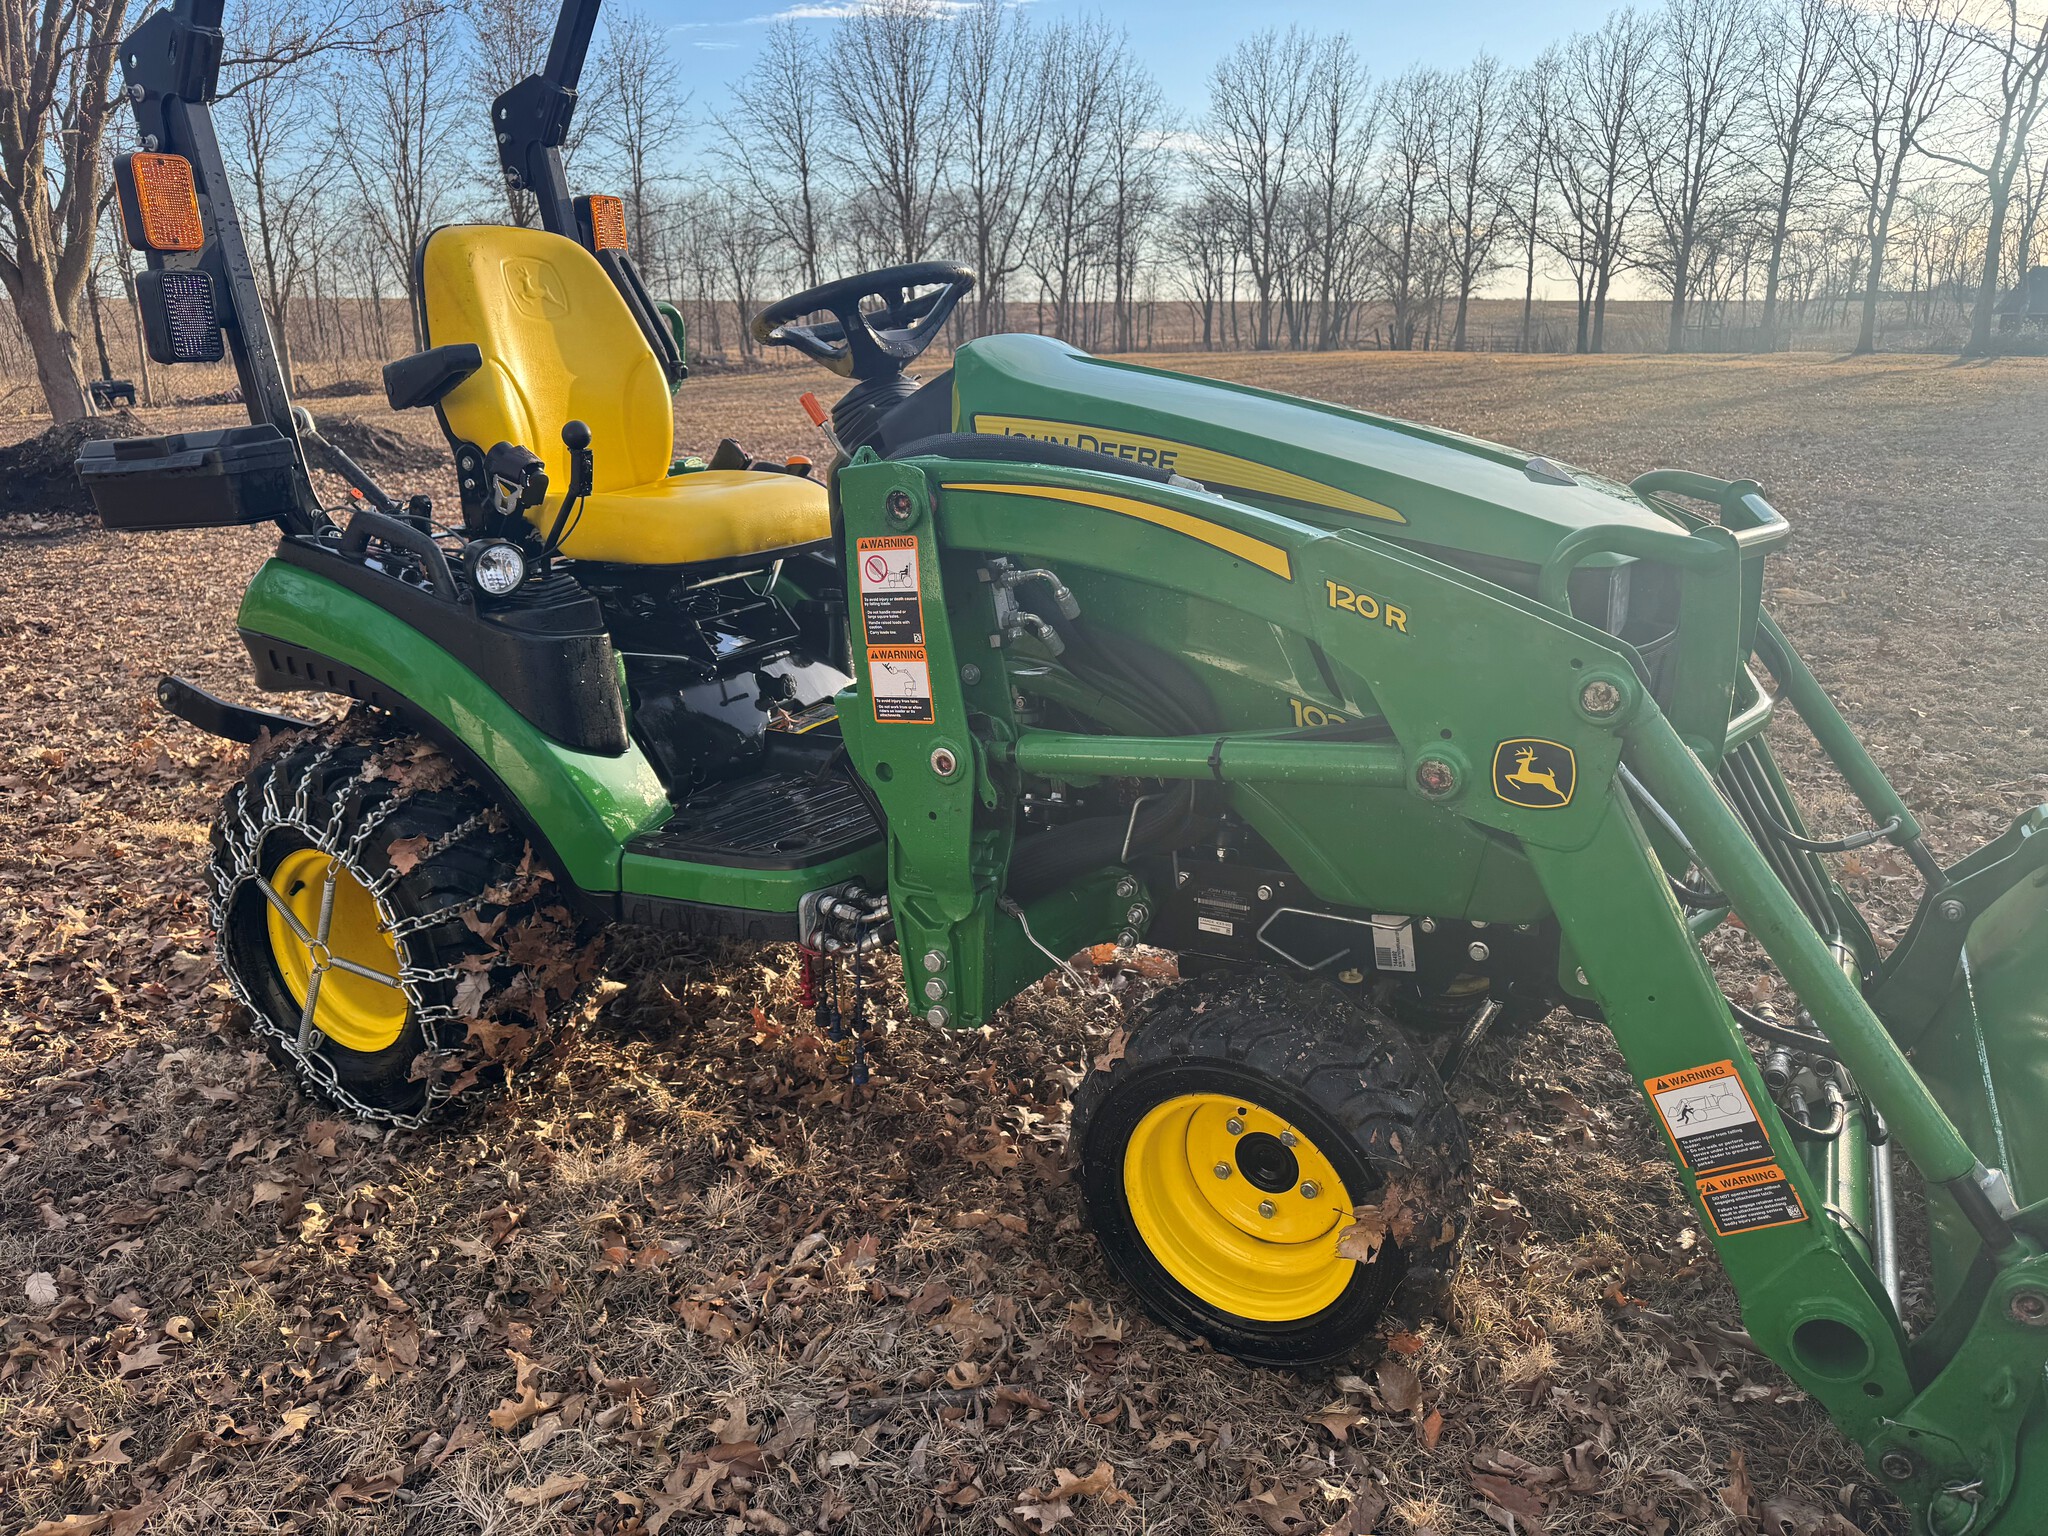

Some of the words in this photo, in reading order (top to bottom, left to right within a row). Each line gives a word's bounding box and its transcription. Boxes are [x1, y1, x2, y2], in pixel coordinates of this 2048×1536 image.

[869, 538, 914, 548] WARNING
[1326, 580, 1380, 619] 120
[1385, 603, 1408, 634] R
[879, 650, 924, 659] WARNING
[1668, 1066, 1725, 1086] WARNING
[1720, 1170, 1777, 1188] WARNING
